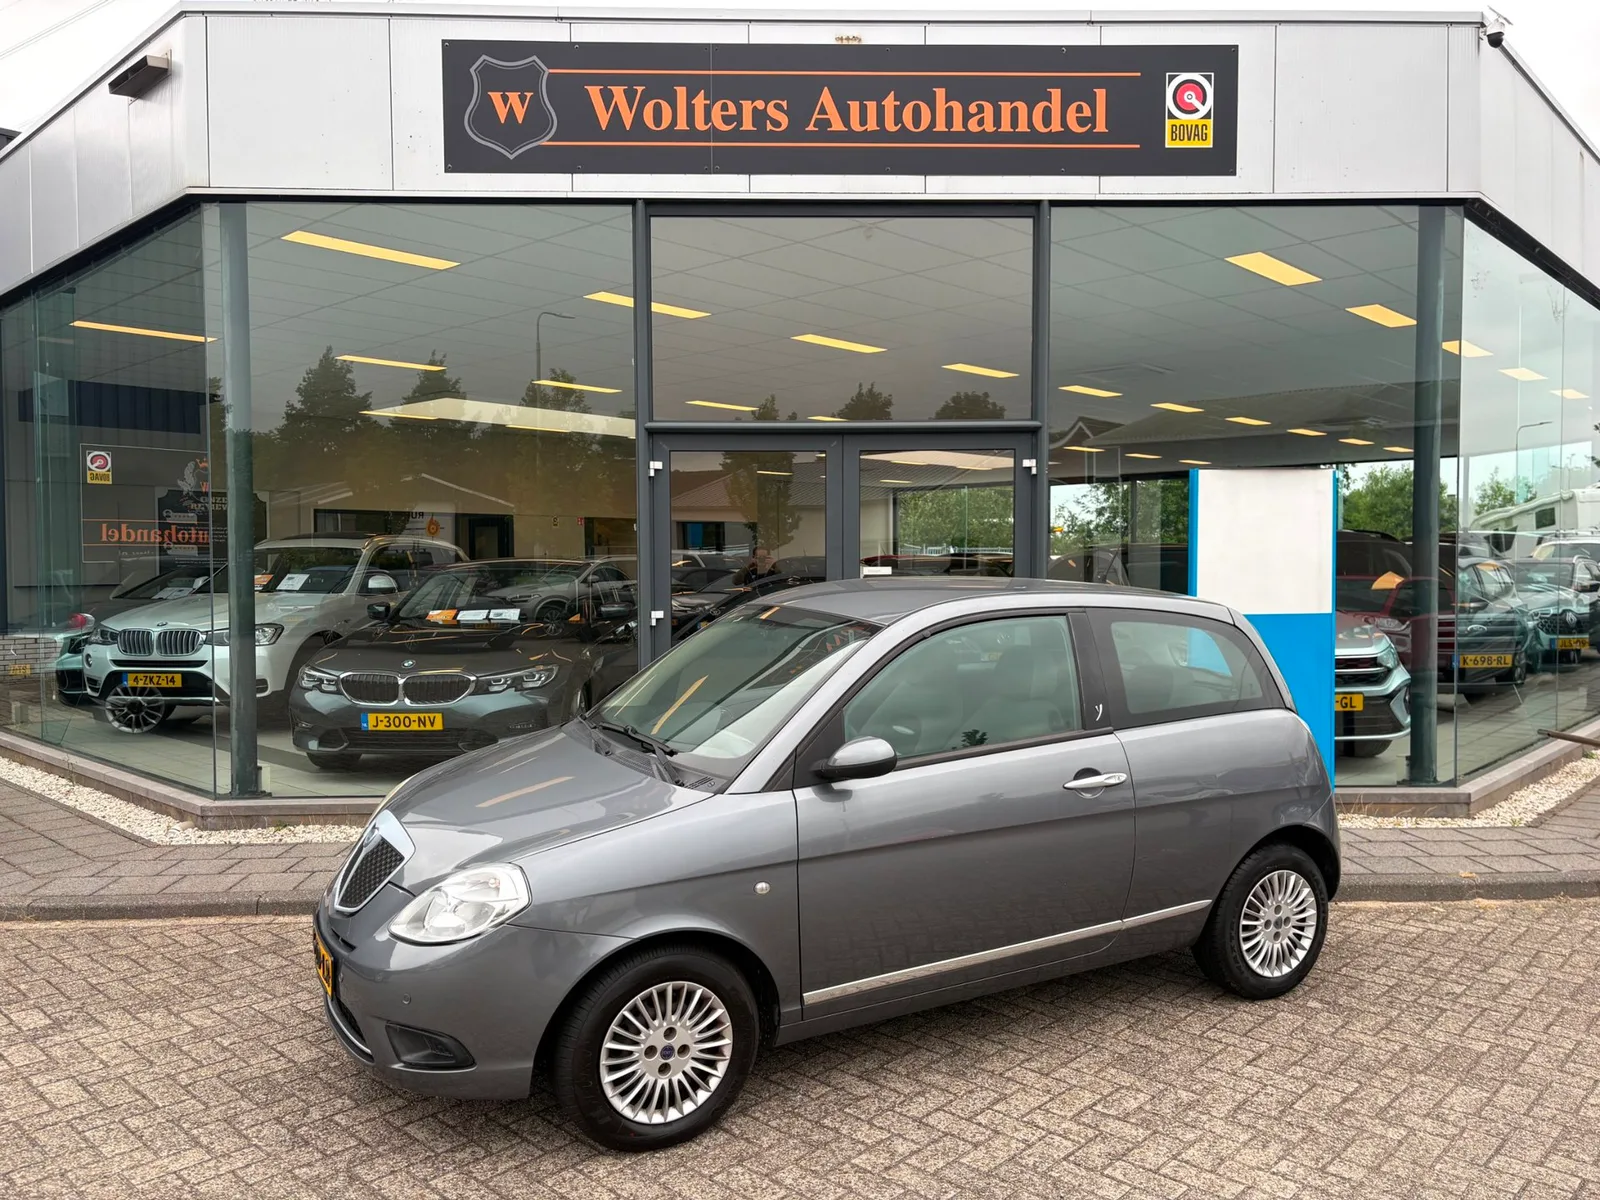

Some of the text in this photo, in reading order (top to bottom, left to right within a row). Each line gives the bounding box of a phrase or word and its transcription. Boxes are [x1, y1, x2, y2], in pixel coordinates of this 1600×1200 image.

[487, 90, 535, 125] W
[585, 84, 1109, 135] Wolters Autohandel
[1171, 124, 1209, 141] BOVAG
[1462, 655, 1510, 667] K-698-RL
[132, 675, 176, 686] 4-ZKZ-14
[372, 715, 437, 728] J-300-NV
